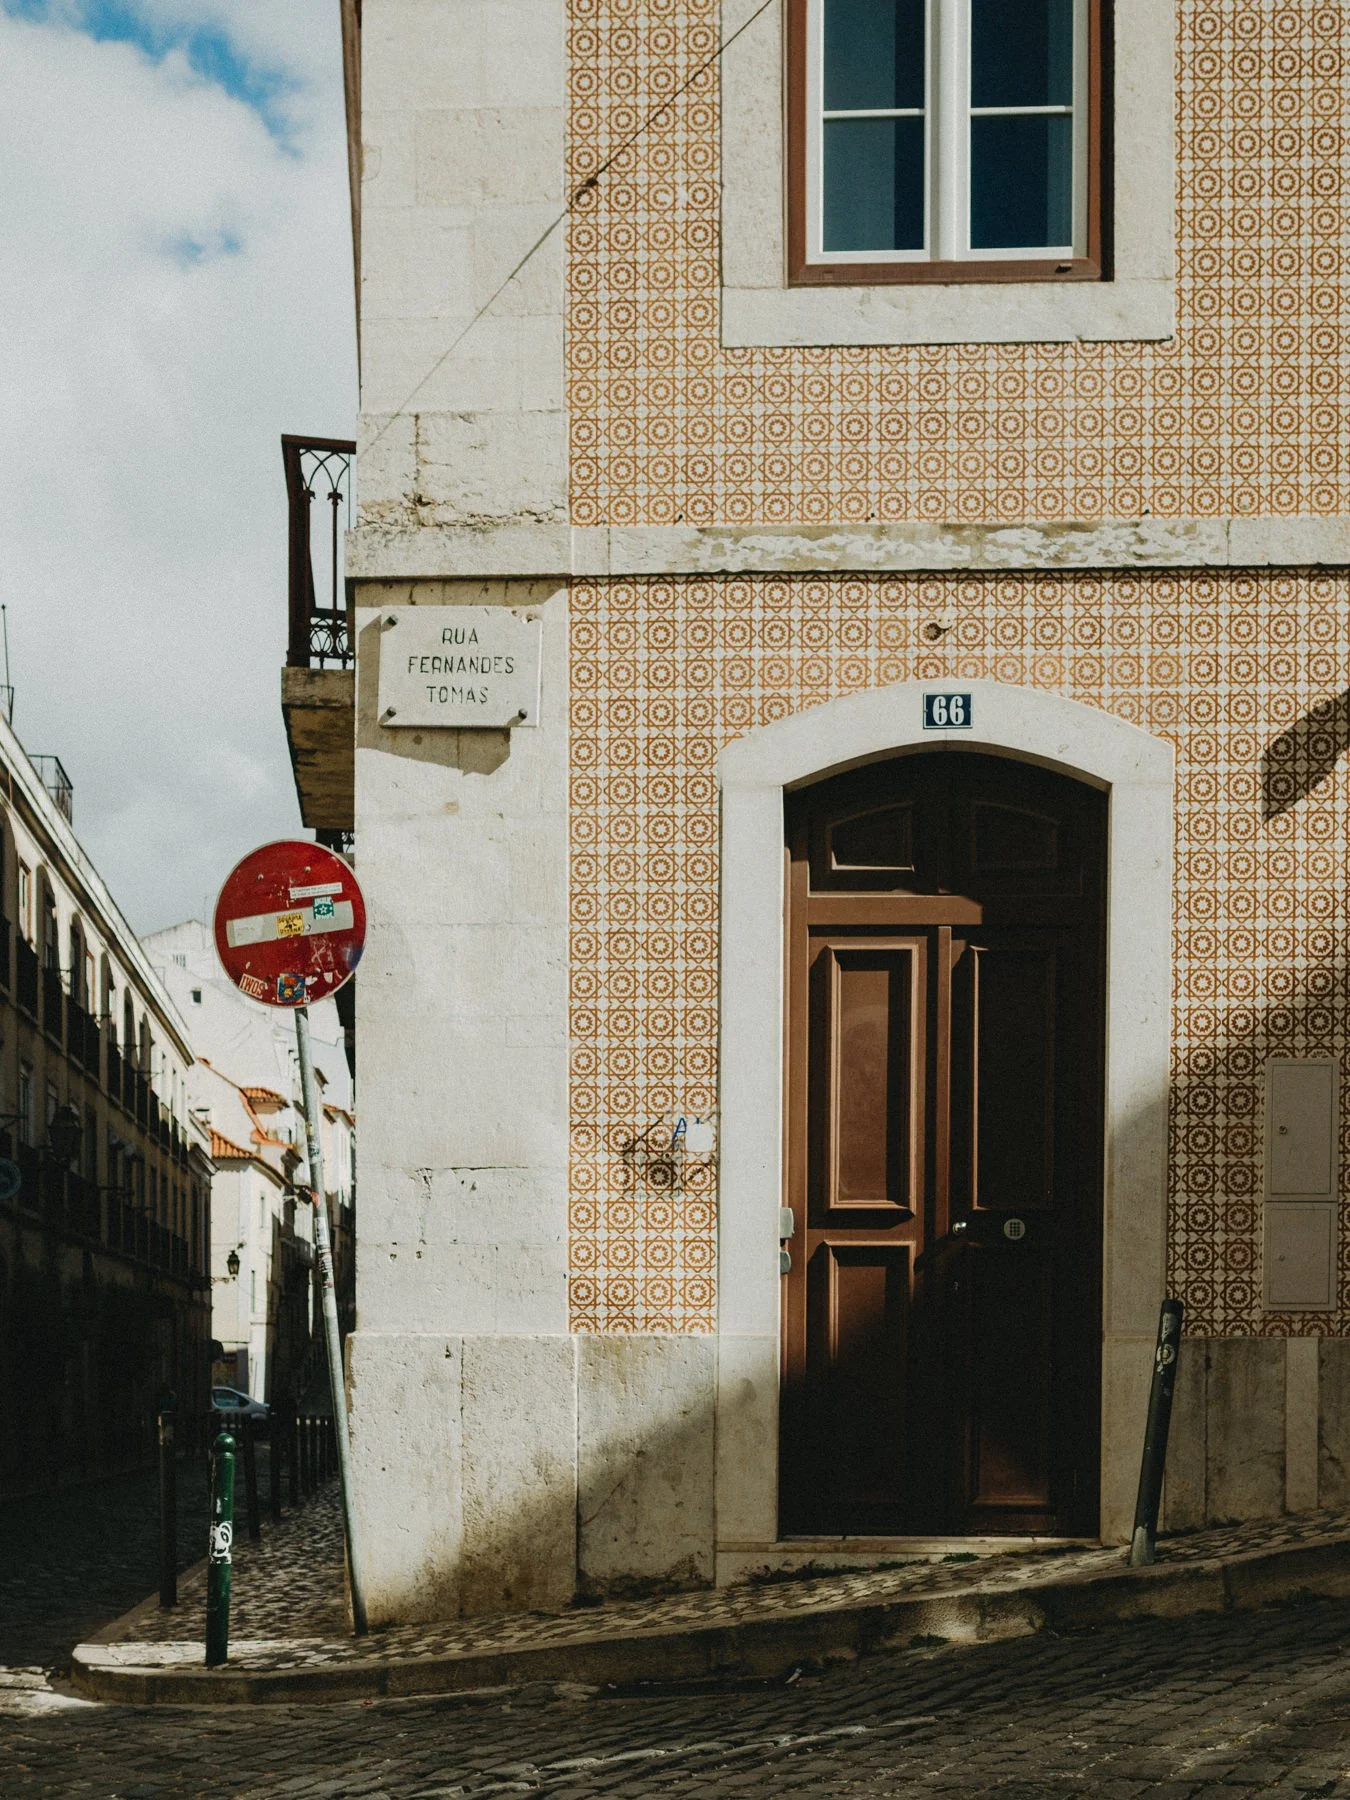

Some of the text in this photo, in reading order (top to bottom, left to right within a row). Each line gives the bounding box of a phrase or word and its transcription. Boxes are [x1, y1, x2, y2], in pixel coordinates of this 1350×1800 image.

[442, 628, 479, 645] RUA
[408, 656, 515, 674] FERNANDES
[426, 686, 489, 704] TOMAS
[932, 695, 965, 726] 66
